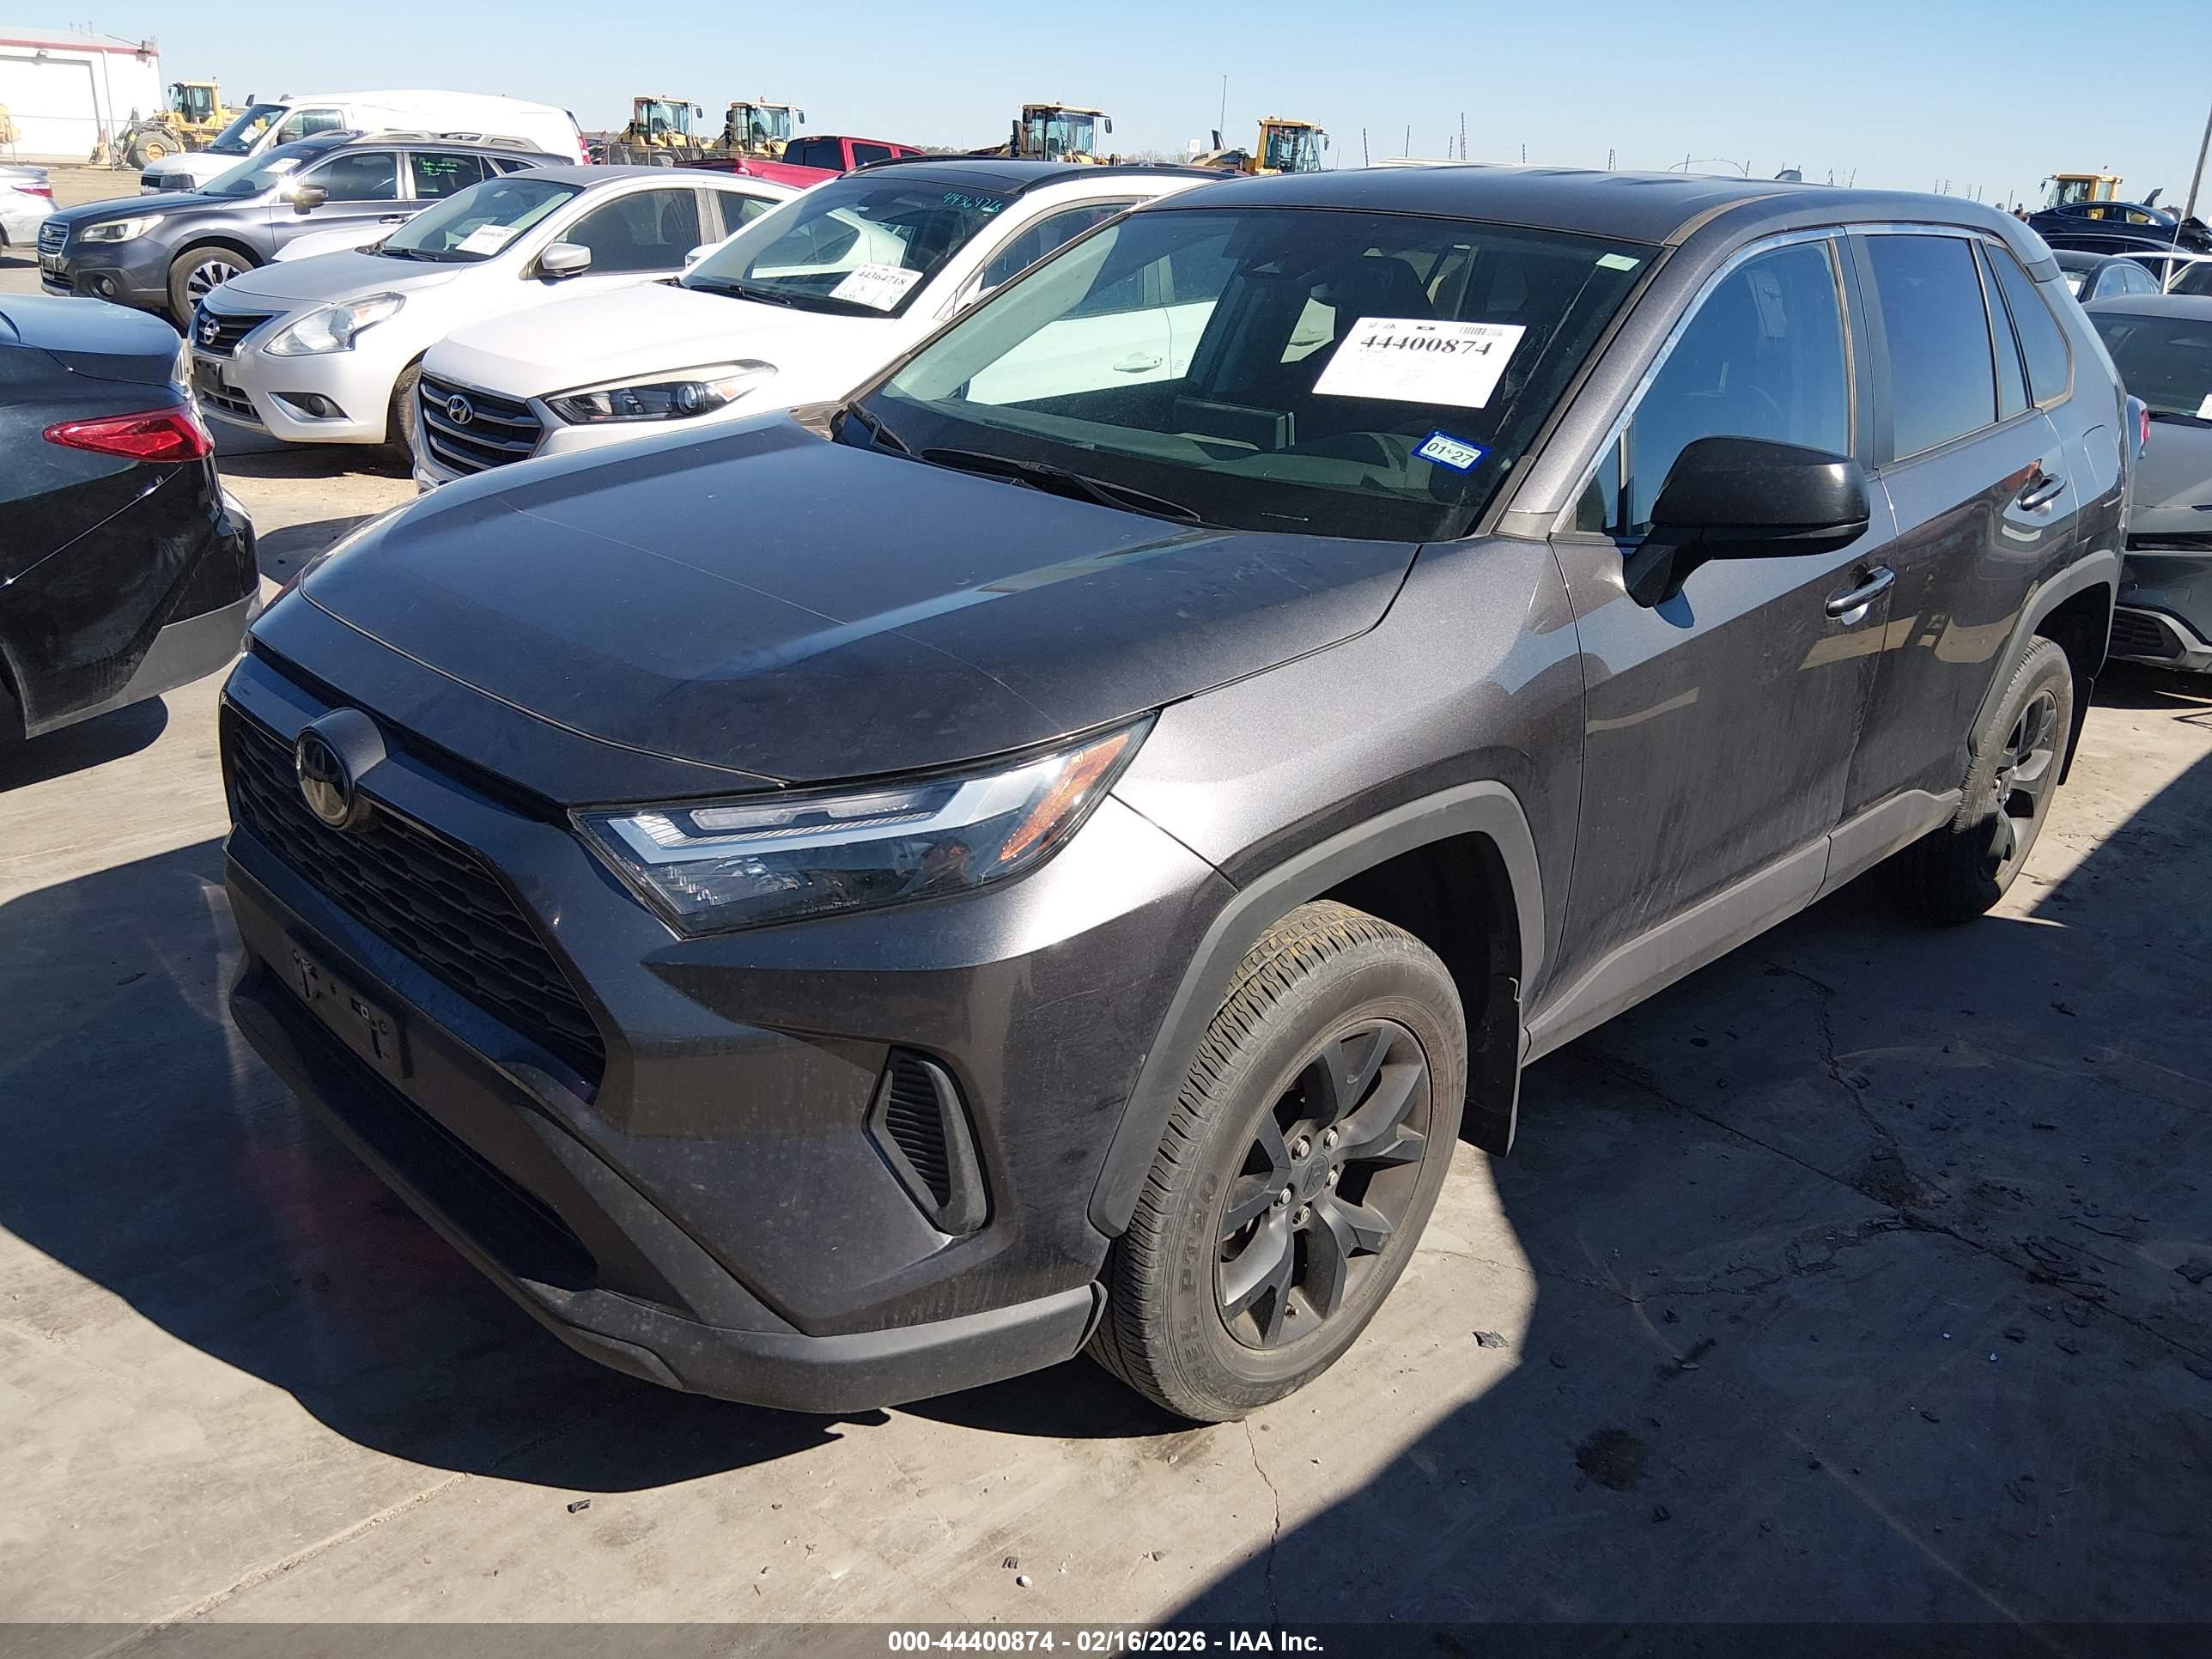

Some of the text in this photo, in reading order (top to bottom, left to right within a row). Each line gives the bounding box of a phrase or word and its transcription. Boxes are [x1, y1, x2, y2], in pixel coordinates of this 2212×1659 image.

[1360, 334, 1493, 356] 44400874
[1426, 442, 1447, 455] 01
[1449, 451, 1474, 464] 27
[1178, 1174, 1220, 1297] PT20
